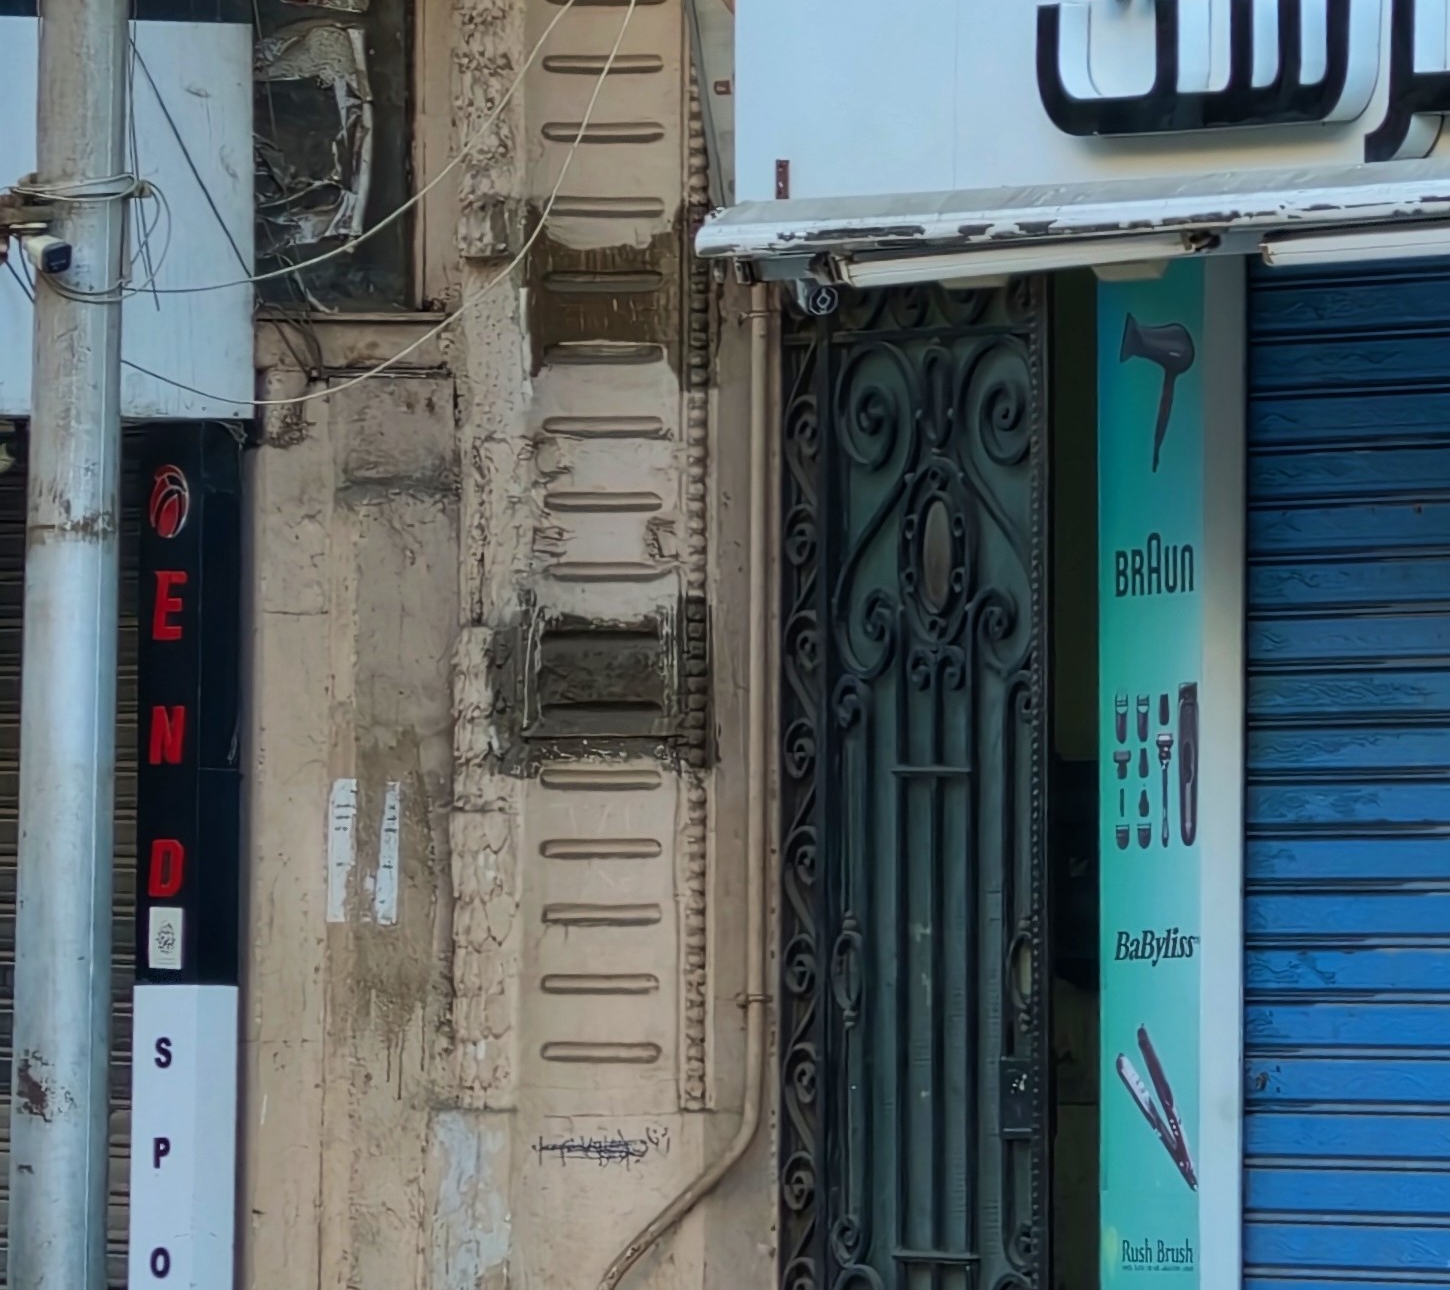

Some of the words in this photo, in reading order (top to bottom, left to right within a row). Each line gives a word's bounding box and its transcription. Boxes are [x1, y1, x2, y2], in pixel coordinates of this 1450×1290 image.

[1115, 531, 1195, 598] BRAUN
[1114, 926, 1194, 968] BaByliss
[1121, 1237, 1153, 1263] Rush
[1156, 1237, 1194, 1264] Brush
